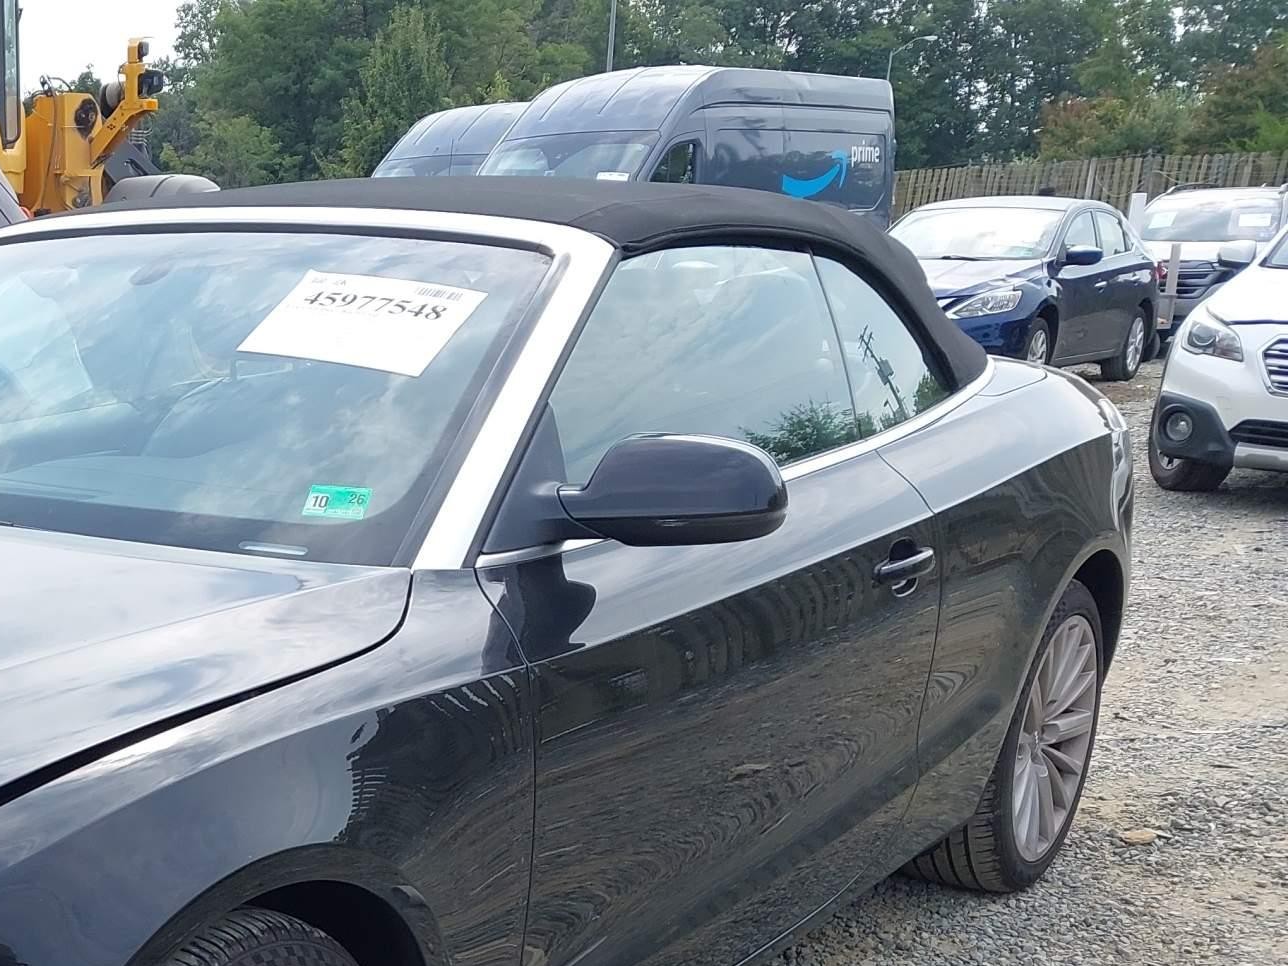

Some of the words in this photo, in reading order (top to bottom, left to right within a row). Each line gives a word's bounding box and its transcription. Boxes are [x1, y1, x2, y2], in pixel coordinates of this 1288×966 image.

[851, 139, 880, 168] prime
[304, 290, 448, 321] 45977548
[312, 495, 329, 508] 10
[348, 493, 366, 505] 26
